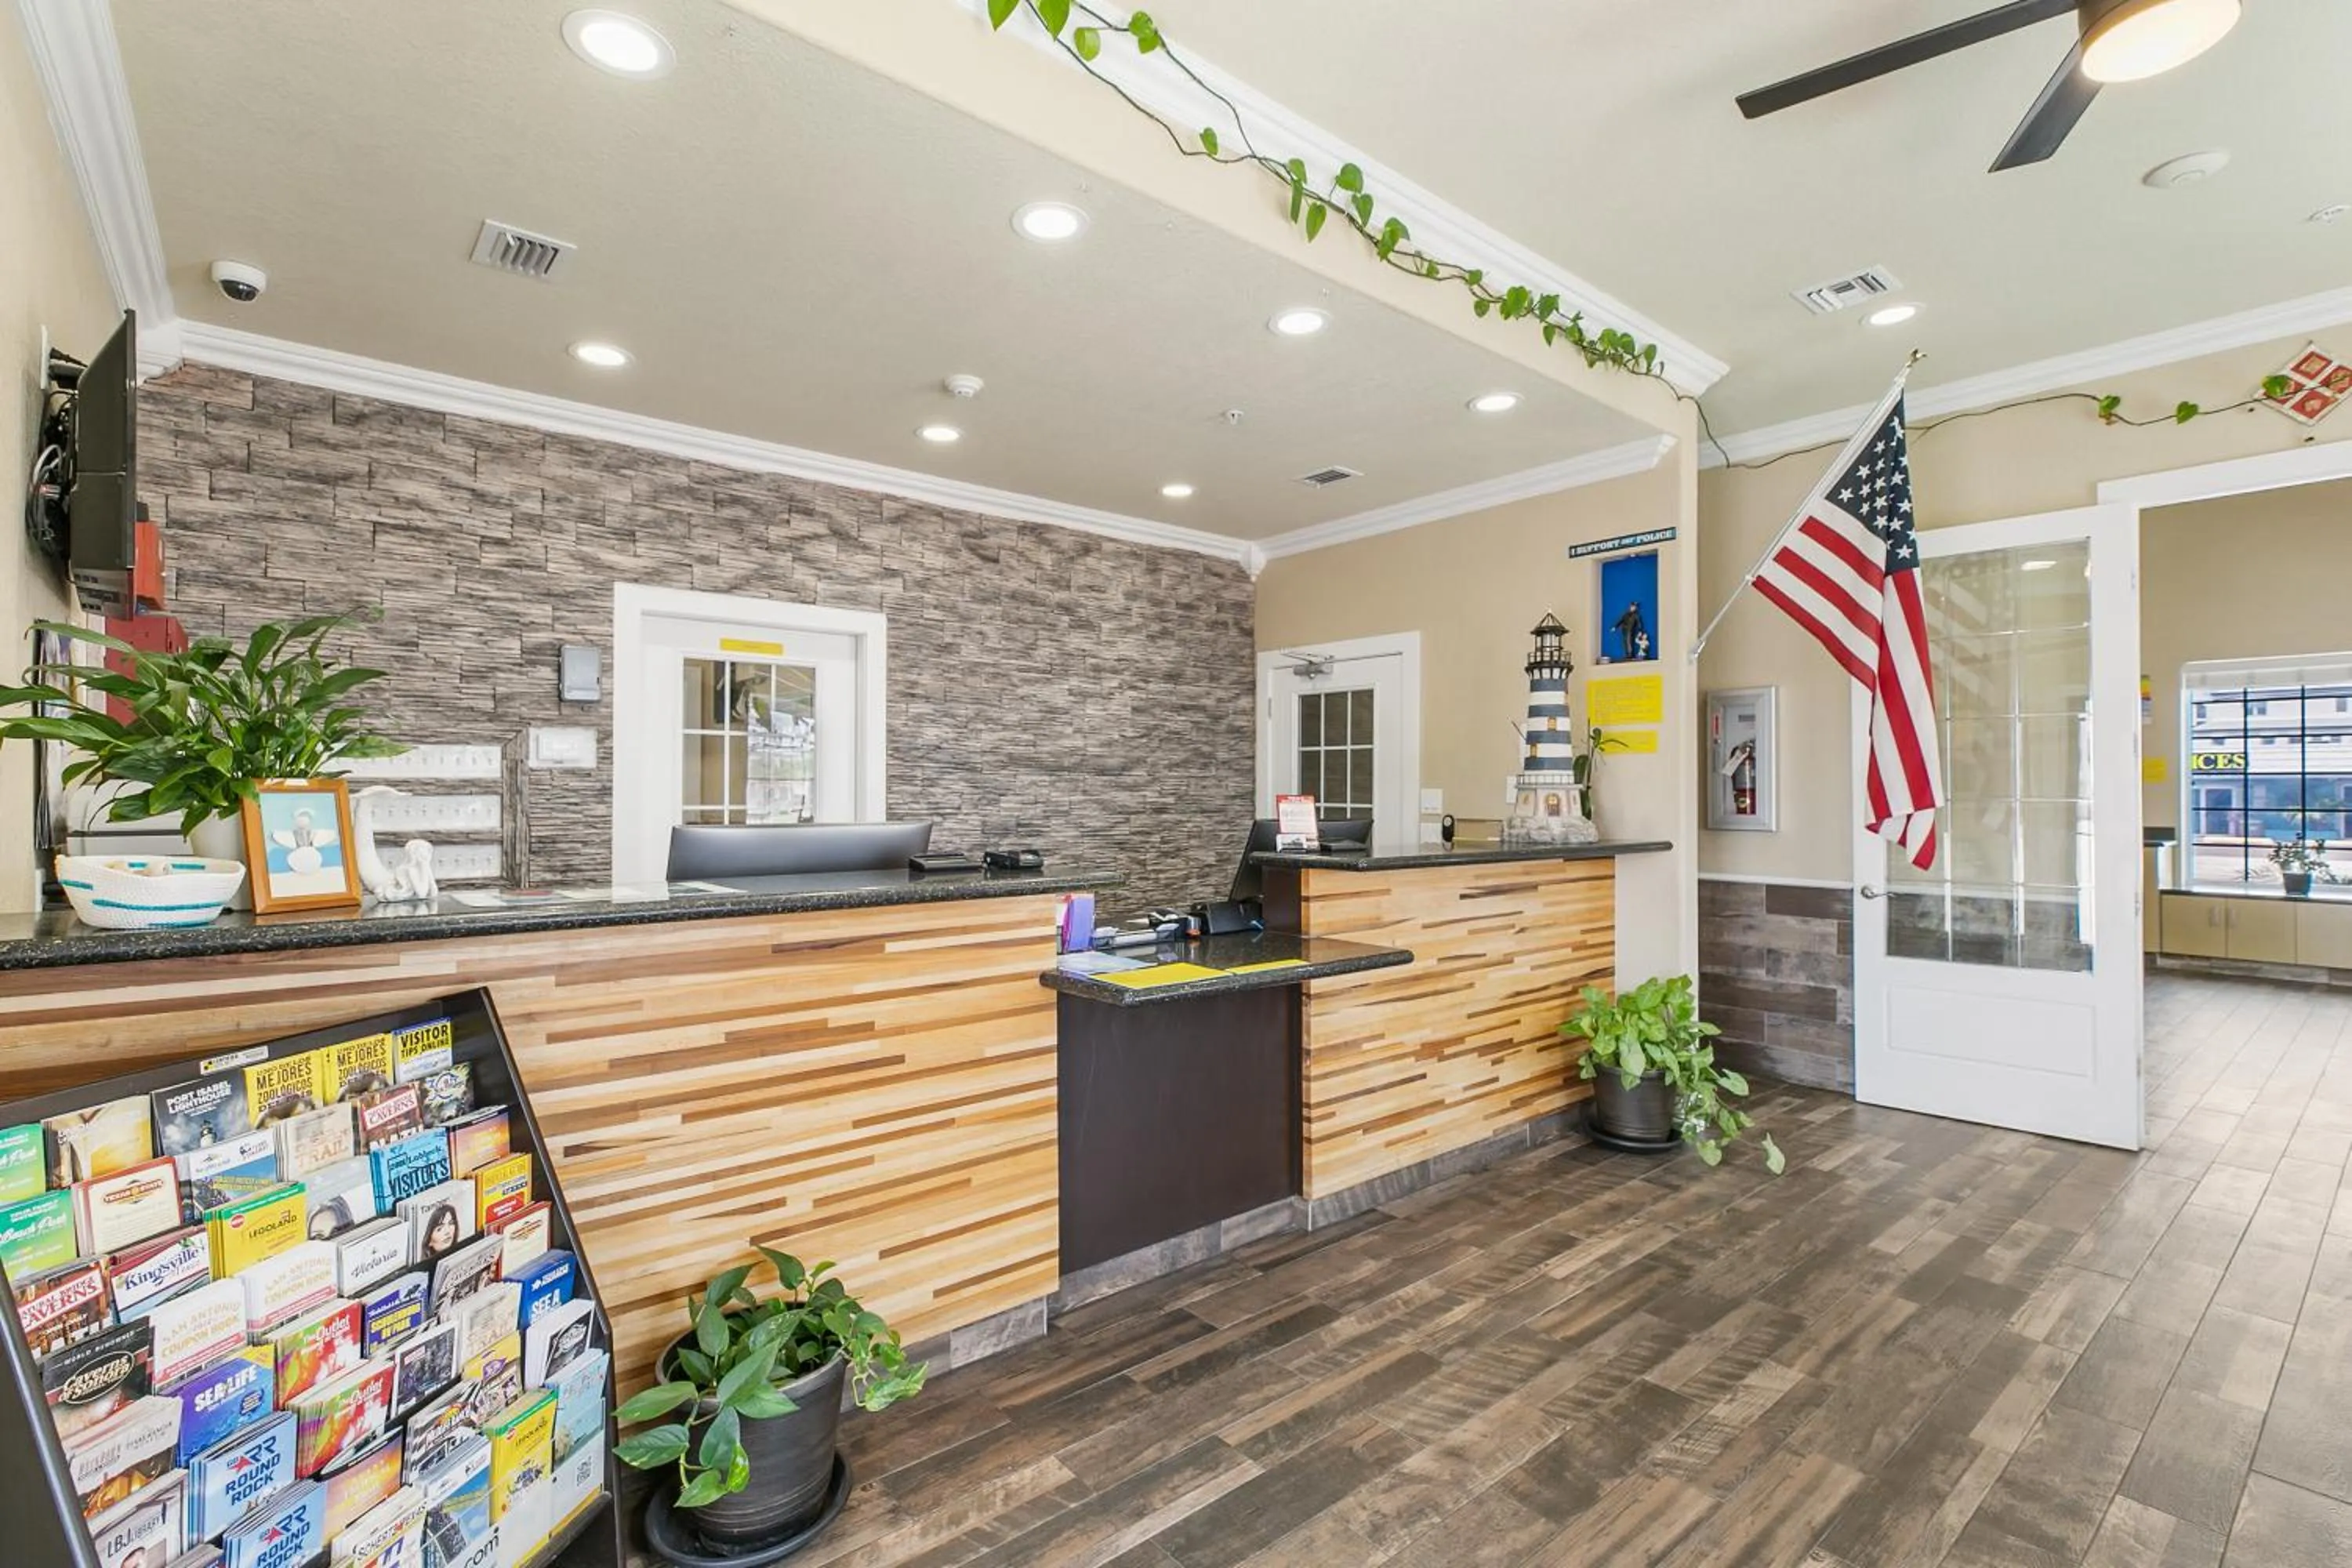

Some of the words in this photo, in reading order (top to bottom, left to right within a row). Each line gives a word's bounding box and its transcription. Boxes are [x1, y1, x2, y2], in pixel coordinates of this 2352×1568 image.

[1577, 539, 1621, 554] SUPPORT
[1637, 529, 1672, 543] POLICE
[401, 1025, 448, 1047] VISITOR
[401, 1046, 418, 1058] TIPS
[421, 1036, 449, 1054] ONLINE
[337, 1044, 386, 1067] MEJORES
[256, 1062, 311, 1091] MEJORES
[166, 1091, 194, 1106] PORT
[197, 1080, 232, 1097] ISABEL
[169, 1087, 233, 1113] LIGHTHOUSE
[368, 1098, 415, 1124] CAVERNS
[249, 1216, 297, 1239] LEGOLAND
[125, 1249, 198, 1290] Kingsville
[64, 1348, 92, 1364] WORLD
[225, 1453, 281, 1495] ROUND
[231, 1470, 274, 1505] ROCK
[107, 1527, 131, 1559] LBJ
[257, 1521, 311, 1568] ROUND
